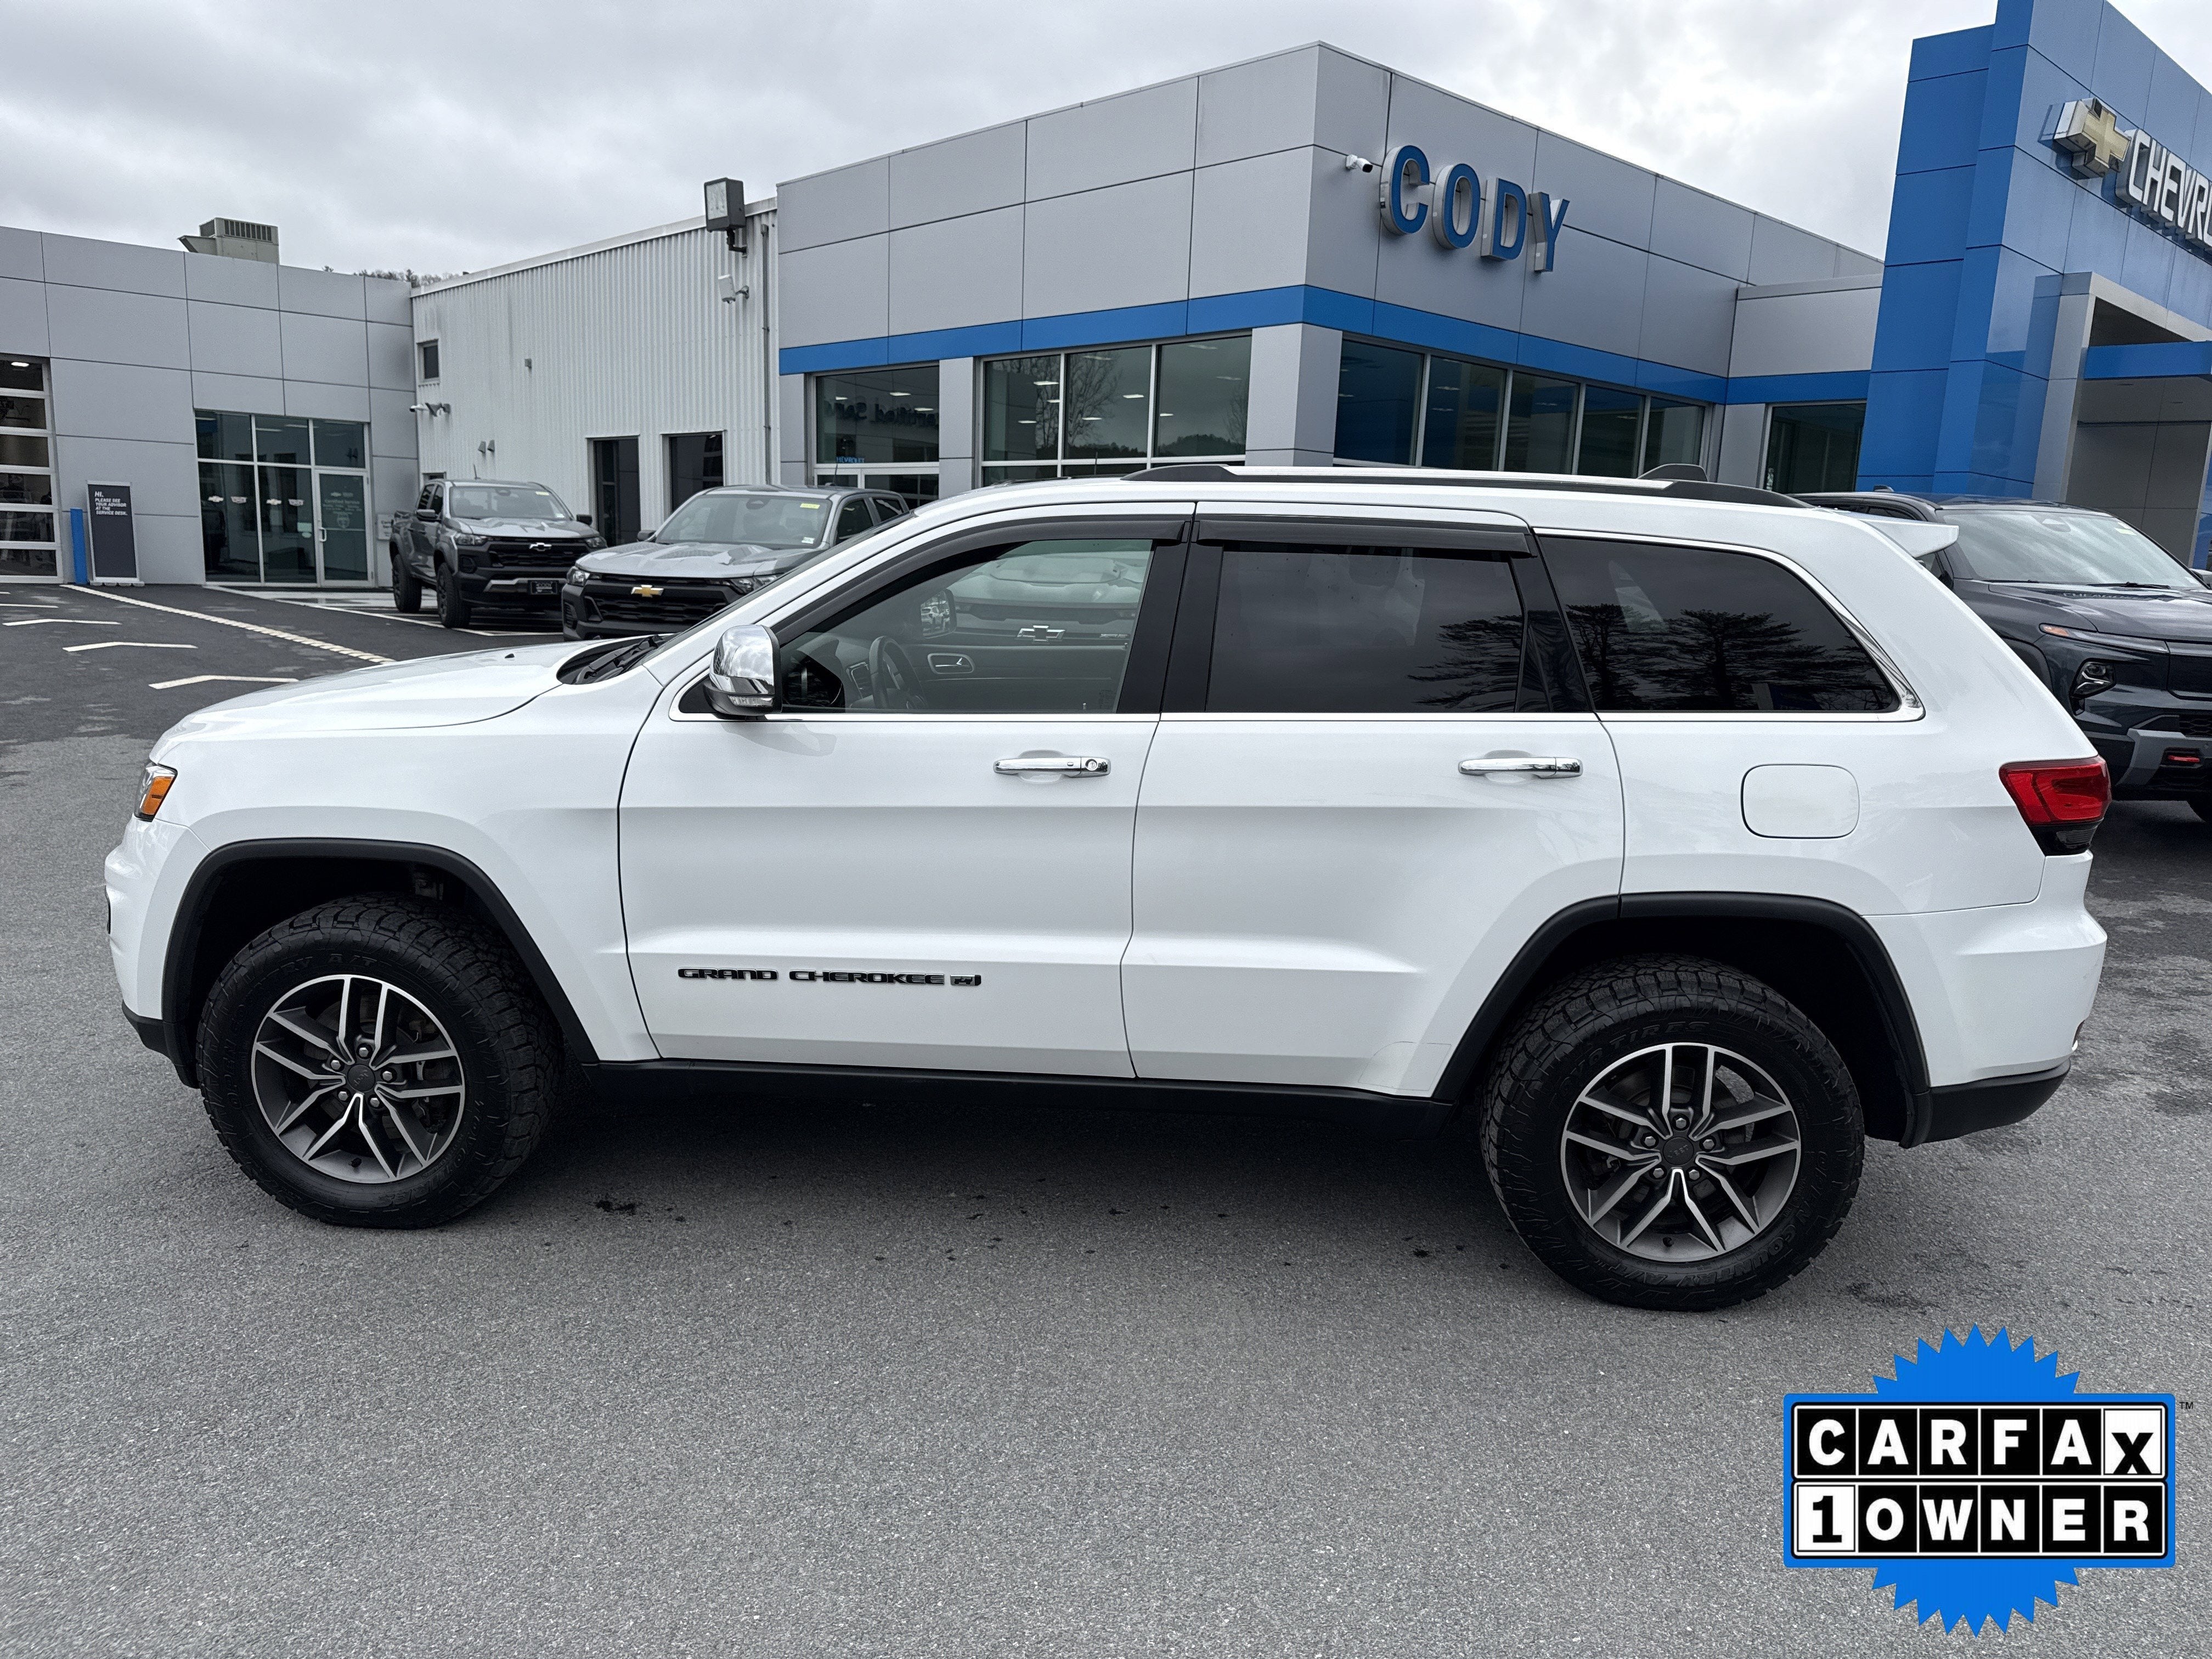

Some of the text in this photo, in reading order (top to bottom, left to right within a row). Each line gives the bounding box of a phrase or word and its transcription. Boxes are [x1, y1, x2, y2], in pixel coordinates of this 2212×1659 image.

[1380, 145, 1570, 273] CODY
[678, 967, 945, 985] GRAND CHEROKEE
[1609, 1020, 1710, 1049] TIRES
[1675, 1223, 1797, 1288] COUNTRY
